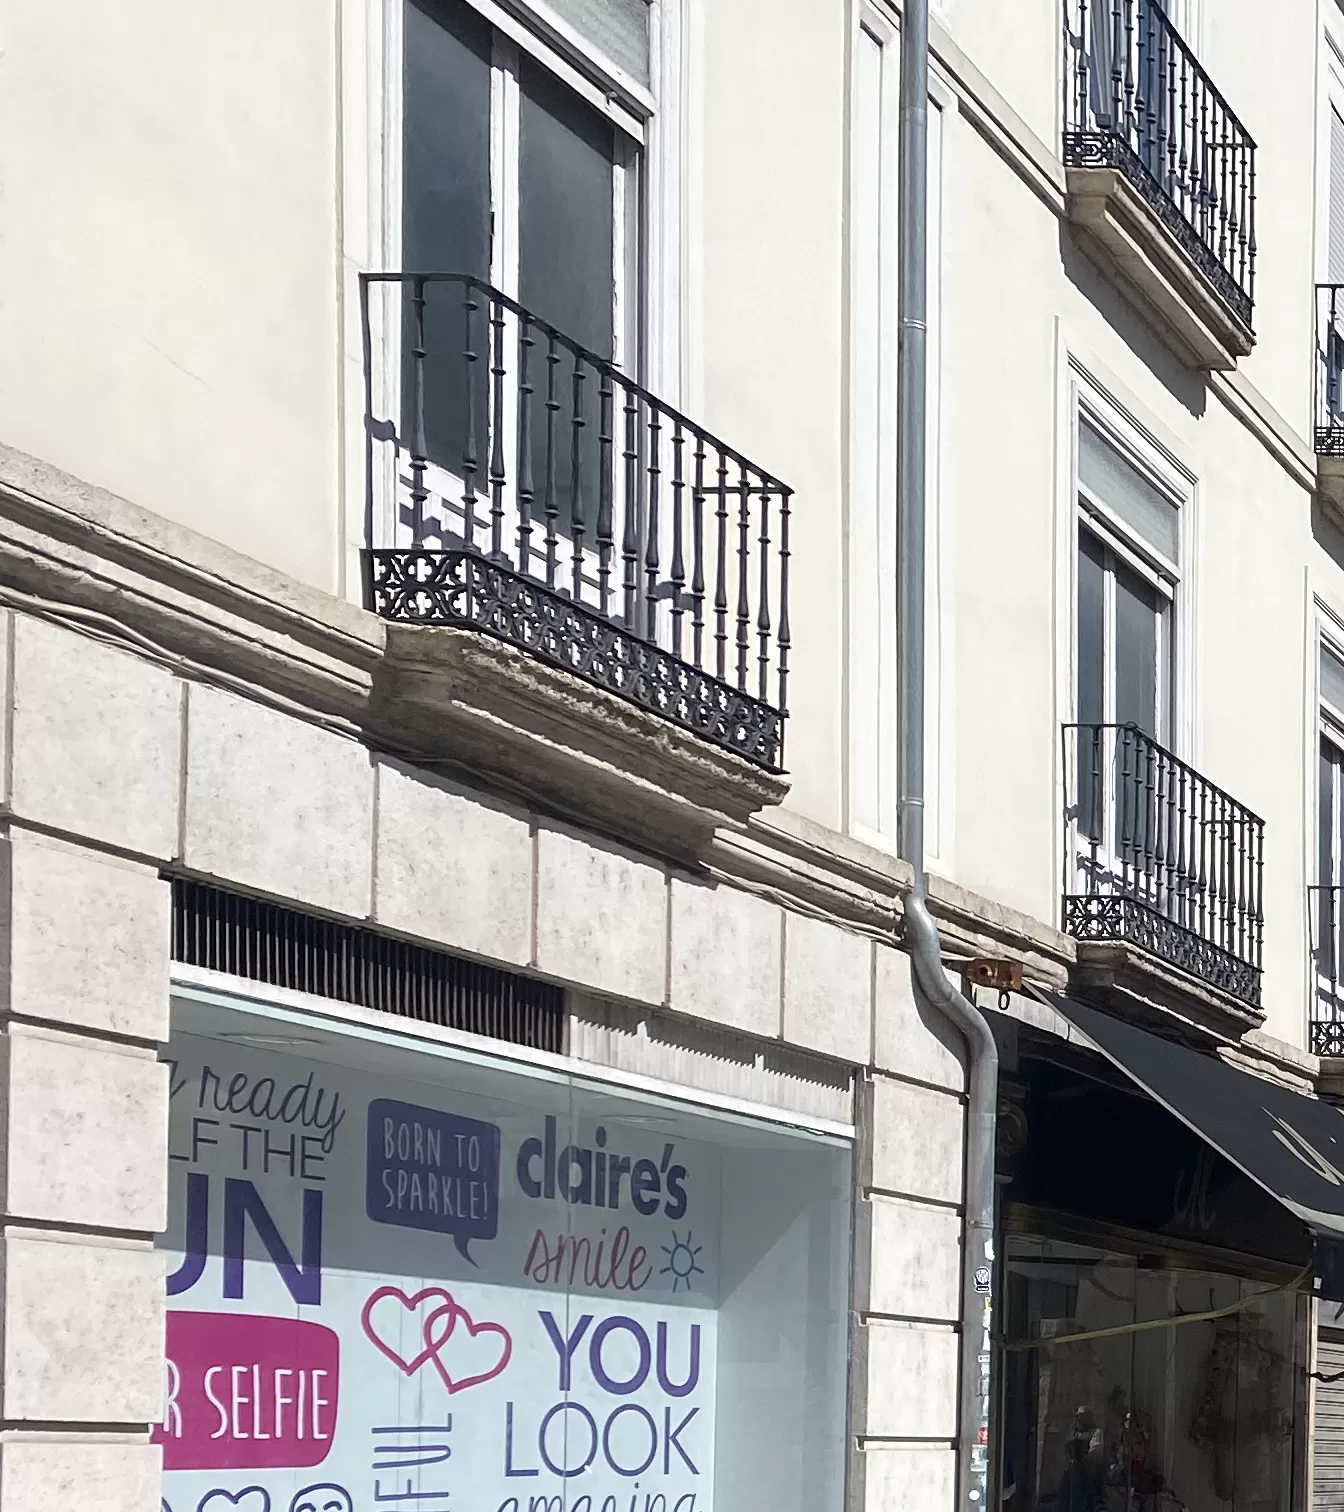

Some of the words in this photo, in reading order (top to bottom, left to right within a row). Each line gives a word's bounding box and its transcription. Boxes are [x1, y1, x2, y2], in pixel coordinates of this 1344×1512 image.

[199, 1066, 346, 1153] ready
[382, 1117, 441, 1165] BORN
[455, 1133, 482, 1174] TO
[230, 1123, 327, 1182] THE
[516, 1115, 690, 1220] claire's
[382, 1168, 491, 1222] SPARKLE!
[523, 1226, 653, 1292] smile
[538, 1309, 701, 1398] YOU
[204, 1363, 329, 1440] SELFIE
[505, 1401, 701, 1478] LOOK
